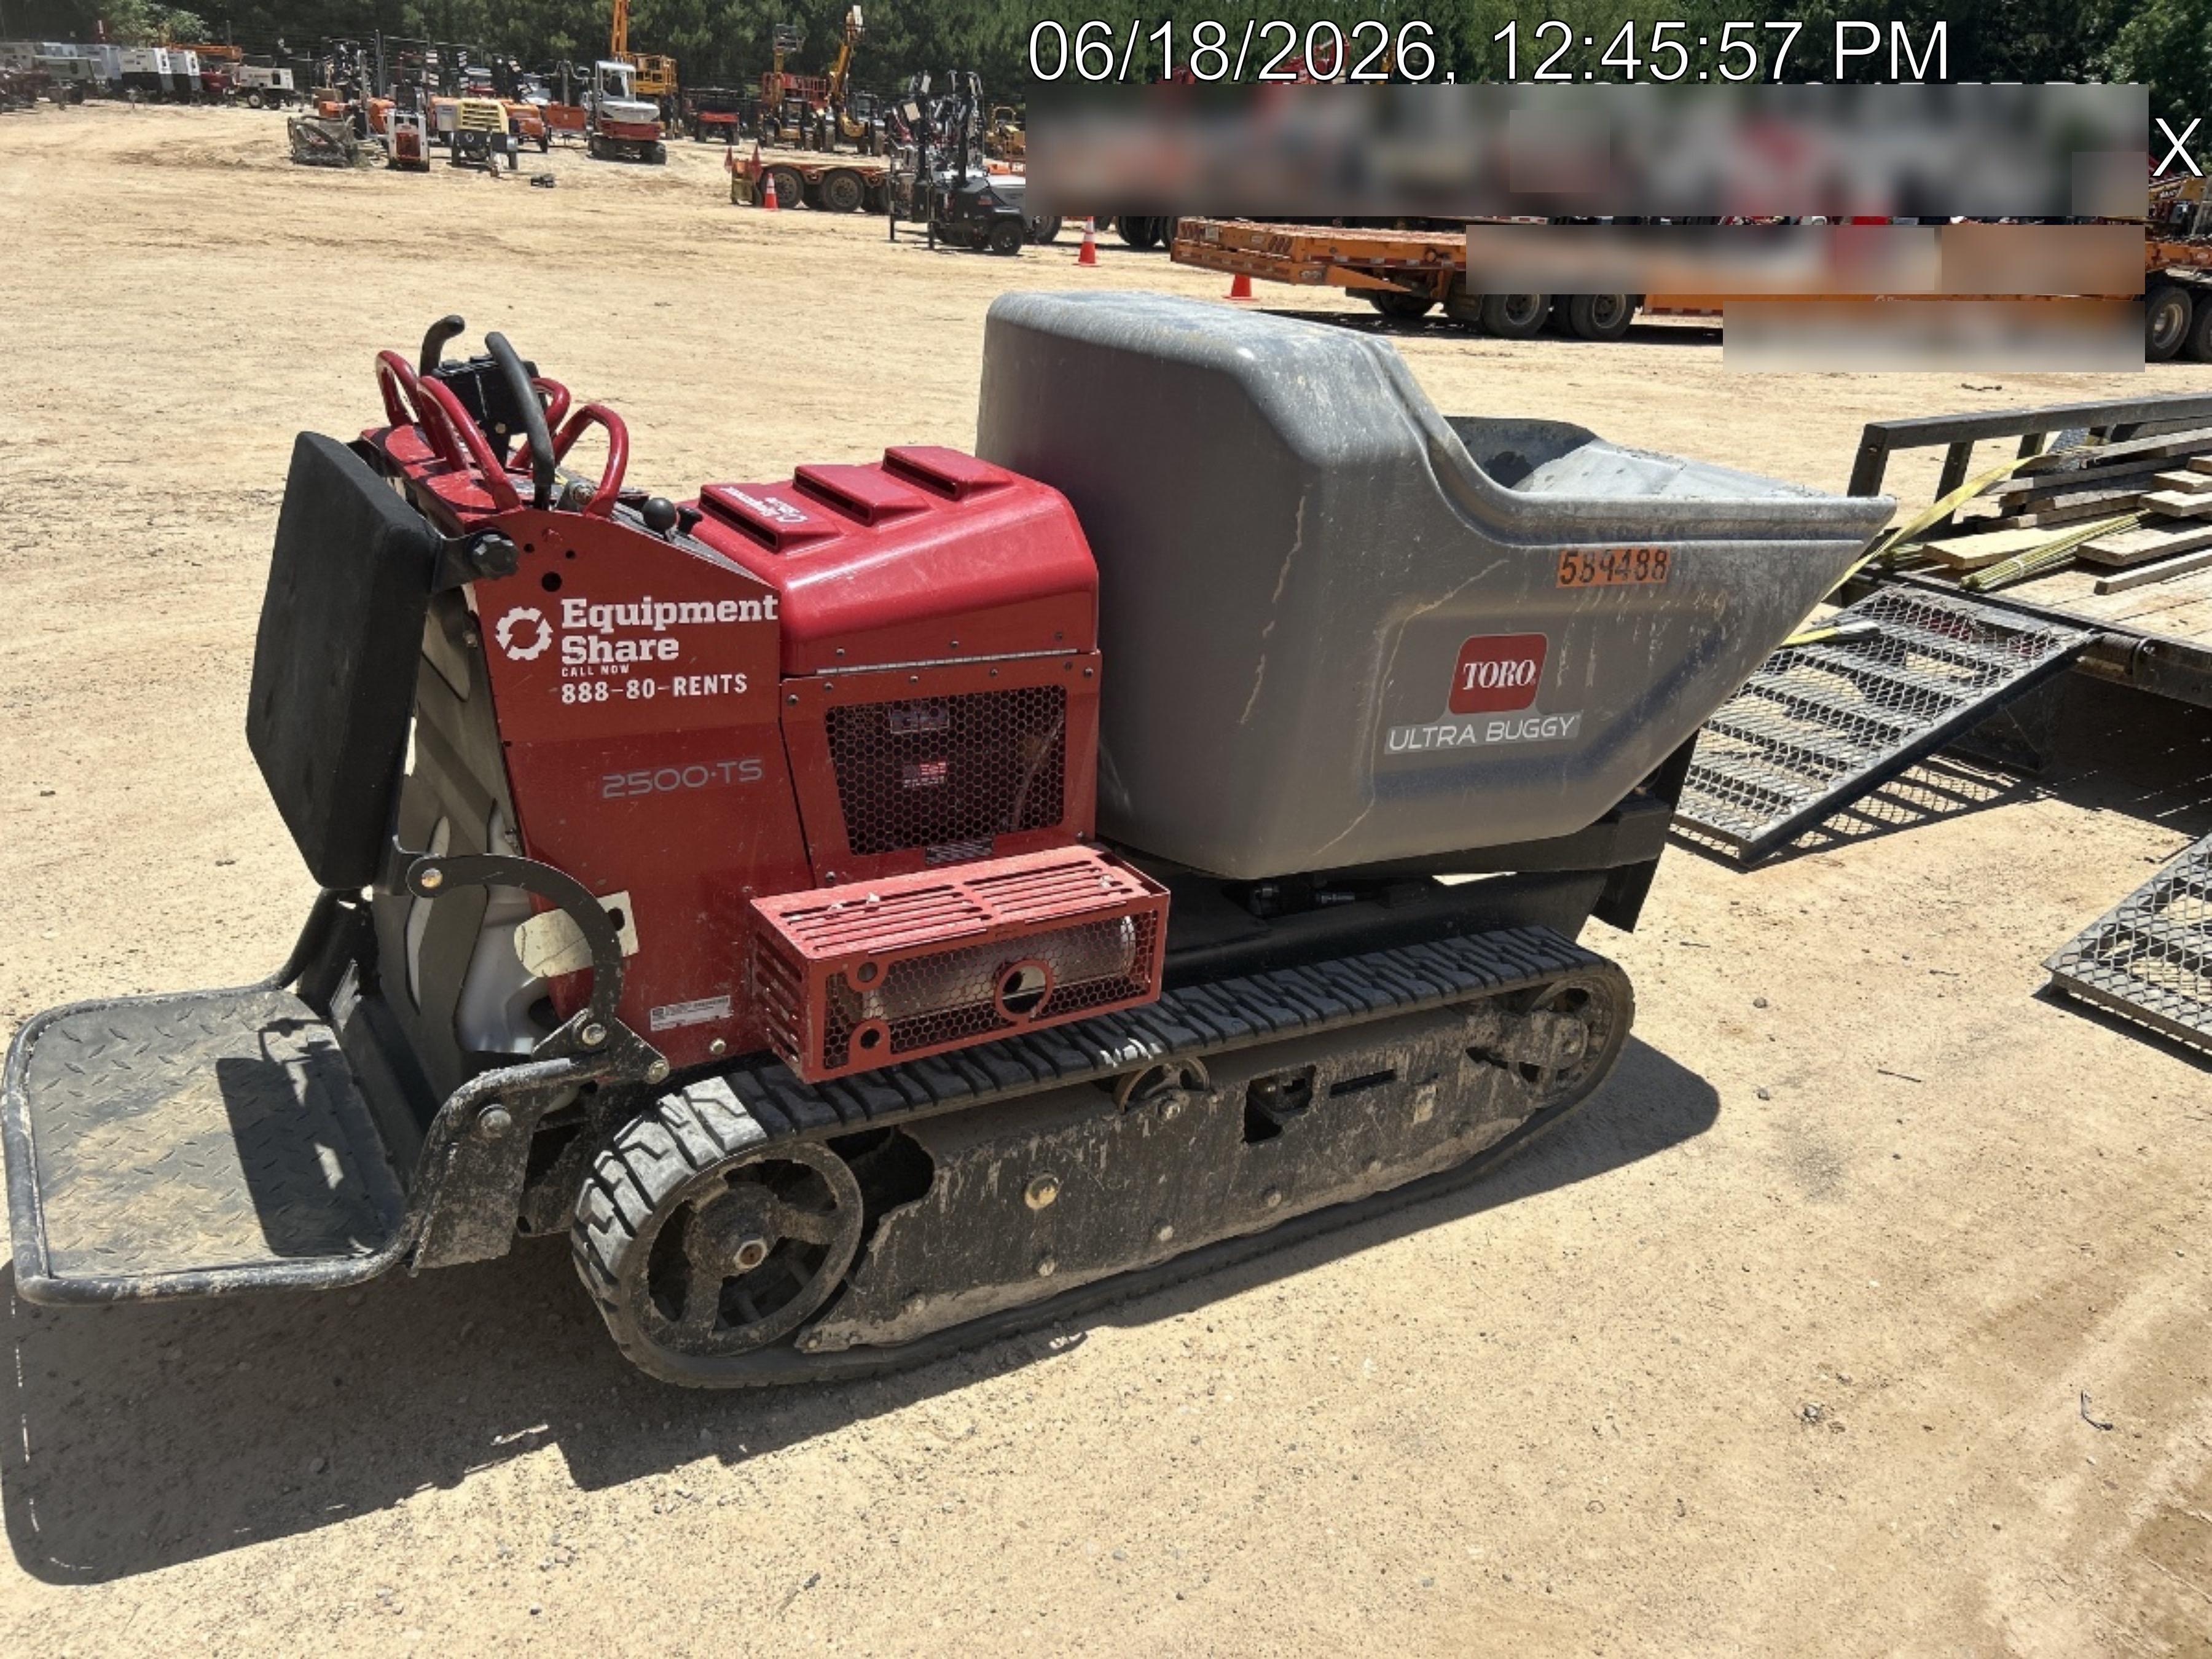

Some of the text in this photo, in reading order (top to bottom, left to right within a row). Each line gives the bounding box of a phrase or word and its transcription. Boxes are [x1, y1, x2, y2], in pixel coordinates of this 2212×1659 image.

[560, 594, 778, 633] Equipment
[561, 635, 679, 664] Share
[562, 665, 629, 677] CALL NOW
[1462, 659, 1536, 690] TORO
[561, 674, 747, 704] 888-80-RENTS
[1389, 716, 1575, 750] ULTRA BUGGY
